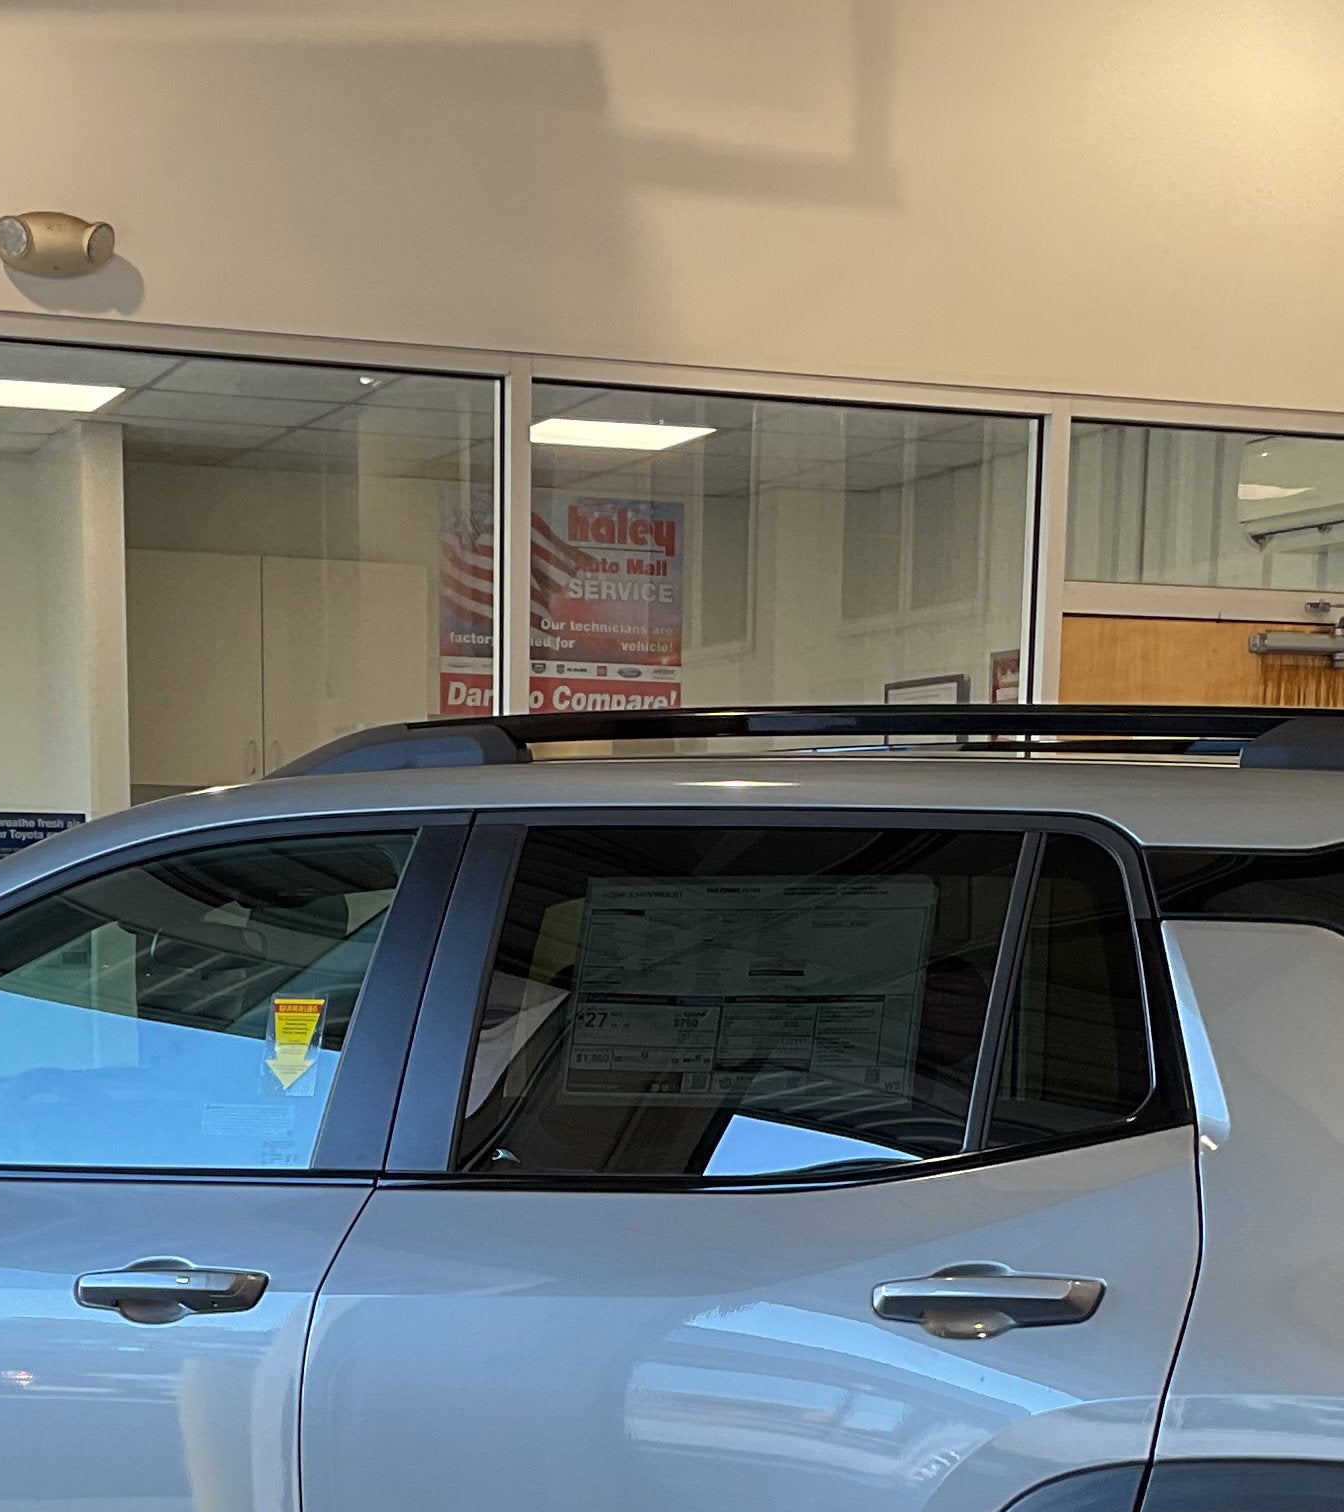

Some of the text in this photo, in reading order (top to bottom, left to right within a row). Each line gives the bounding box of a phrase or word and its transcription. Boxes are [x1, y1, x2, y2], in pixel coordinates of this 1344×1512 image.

[568, 505, 676, 556] haley
[626, 558, 667, 576] Mall
[568, 578, 673, 603] SERVICE
[540, 619, 673, 636] Our technicians are
[557, 637, 576, 650] for
[621, 641, 674, 653] vehicle!
[447, 681, 493, 707] Dar
[552, 685, 677, 711] Compare!
[37, 818, 64, 828] fresh
[10, 829, 44, 841] Toyota
